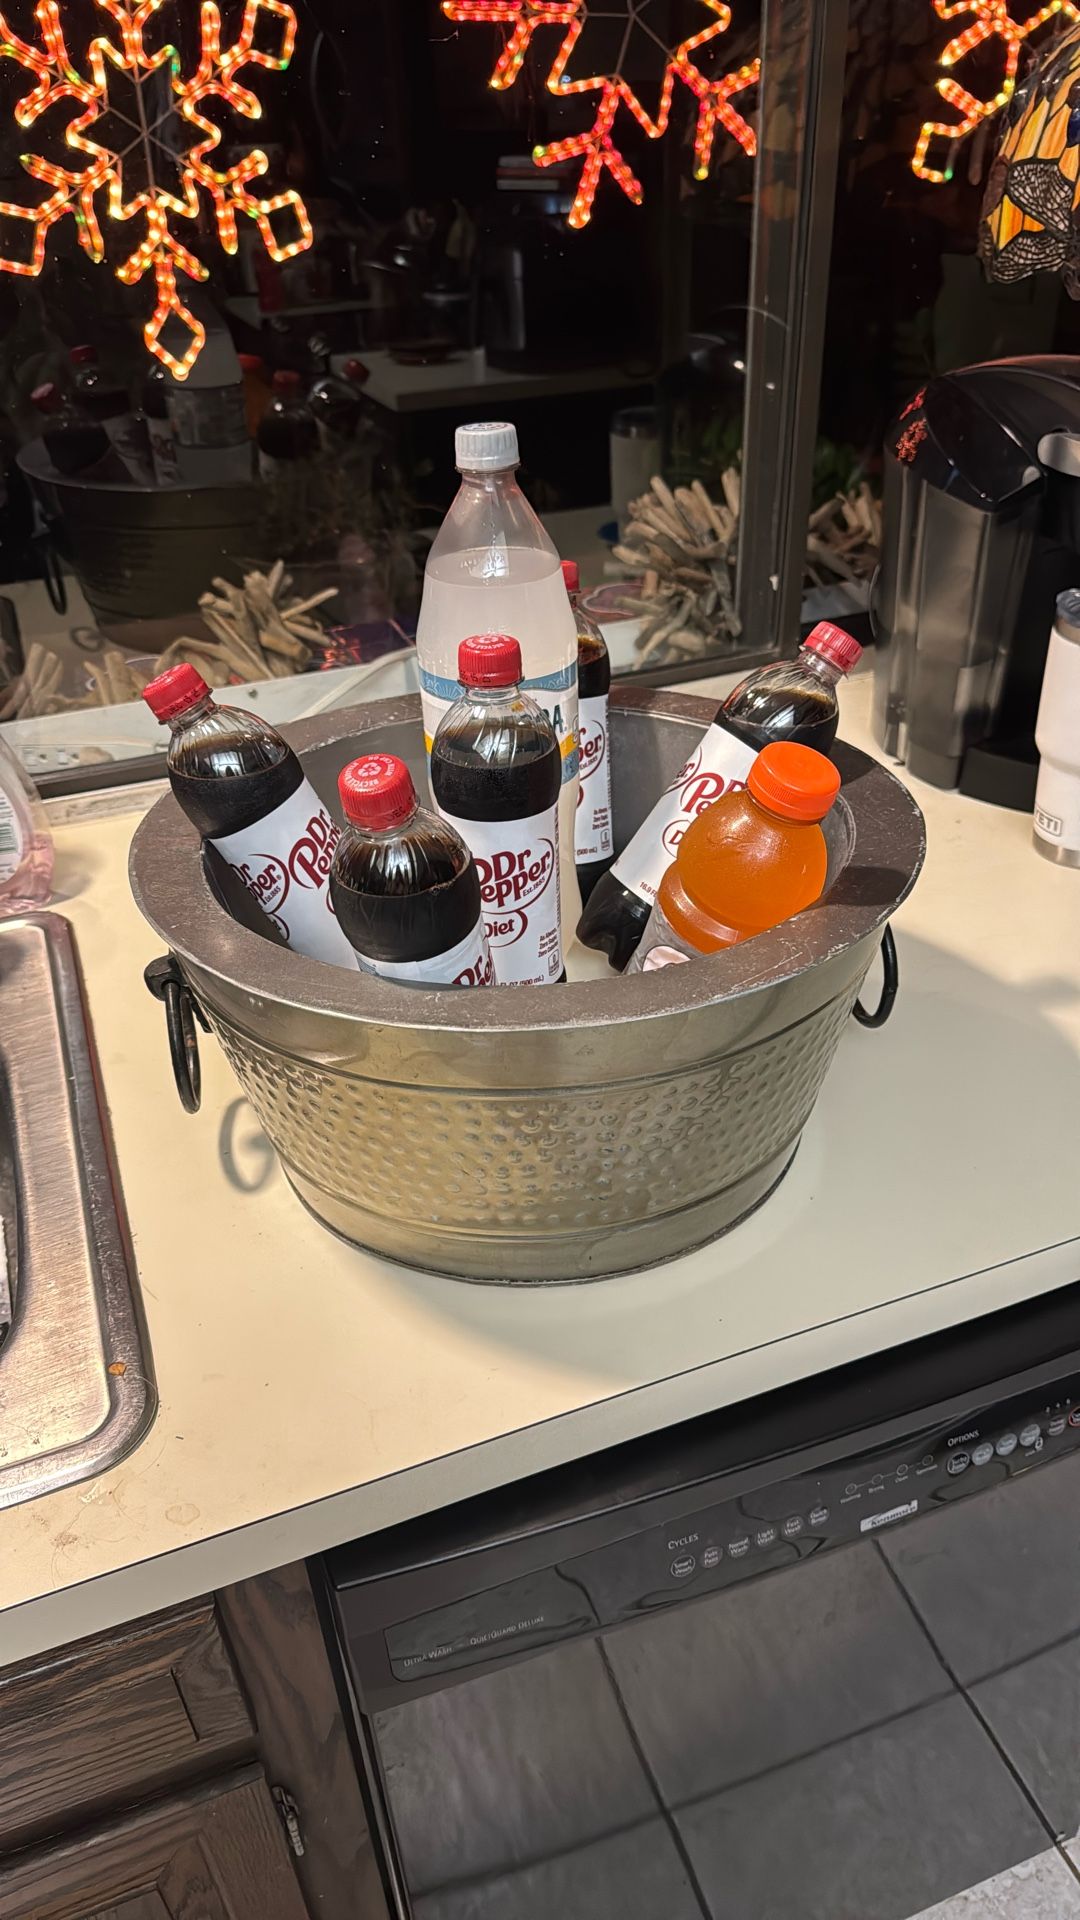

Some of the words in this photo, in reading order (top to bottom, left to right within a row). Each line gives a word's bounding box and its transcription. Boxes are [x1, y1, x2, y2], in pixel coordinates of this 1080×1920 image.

[491, 849, 531, 882] Dr
[947, 1430, 980, 1447] OPTIONS
[668, 1533, 699, 1549] CYCLES
